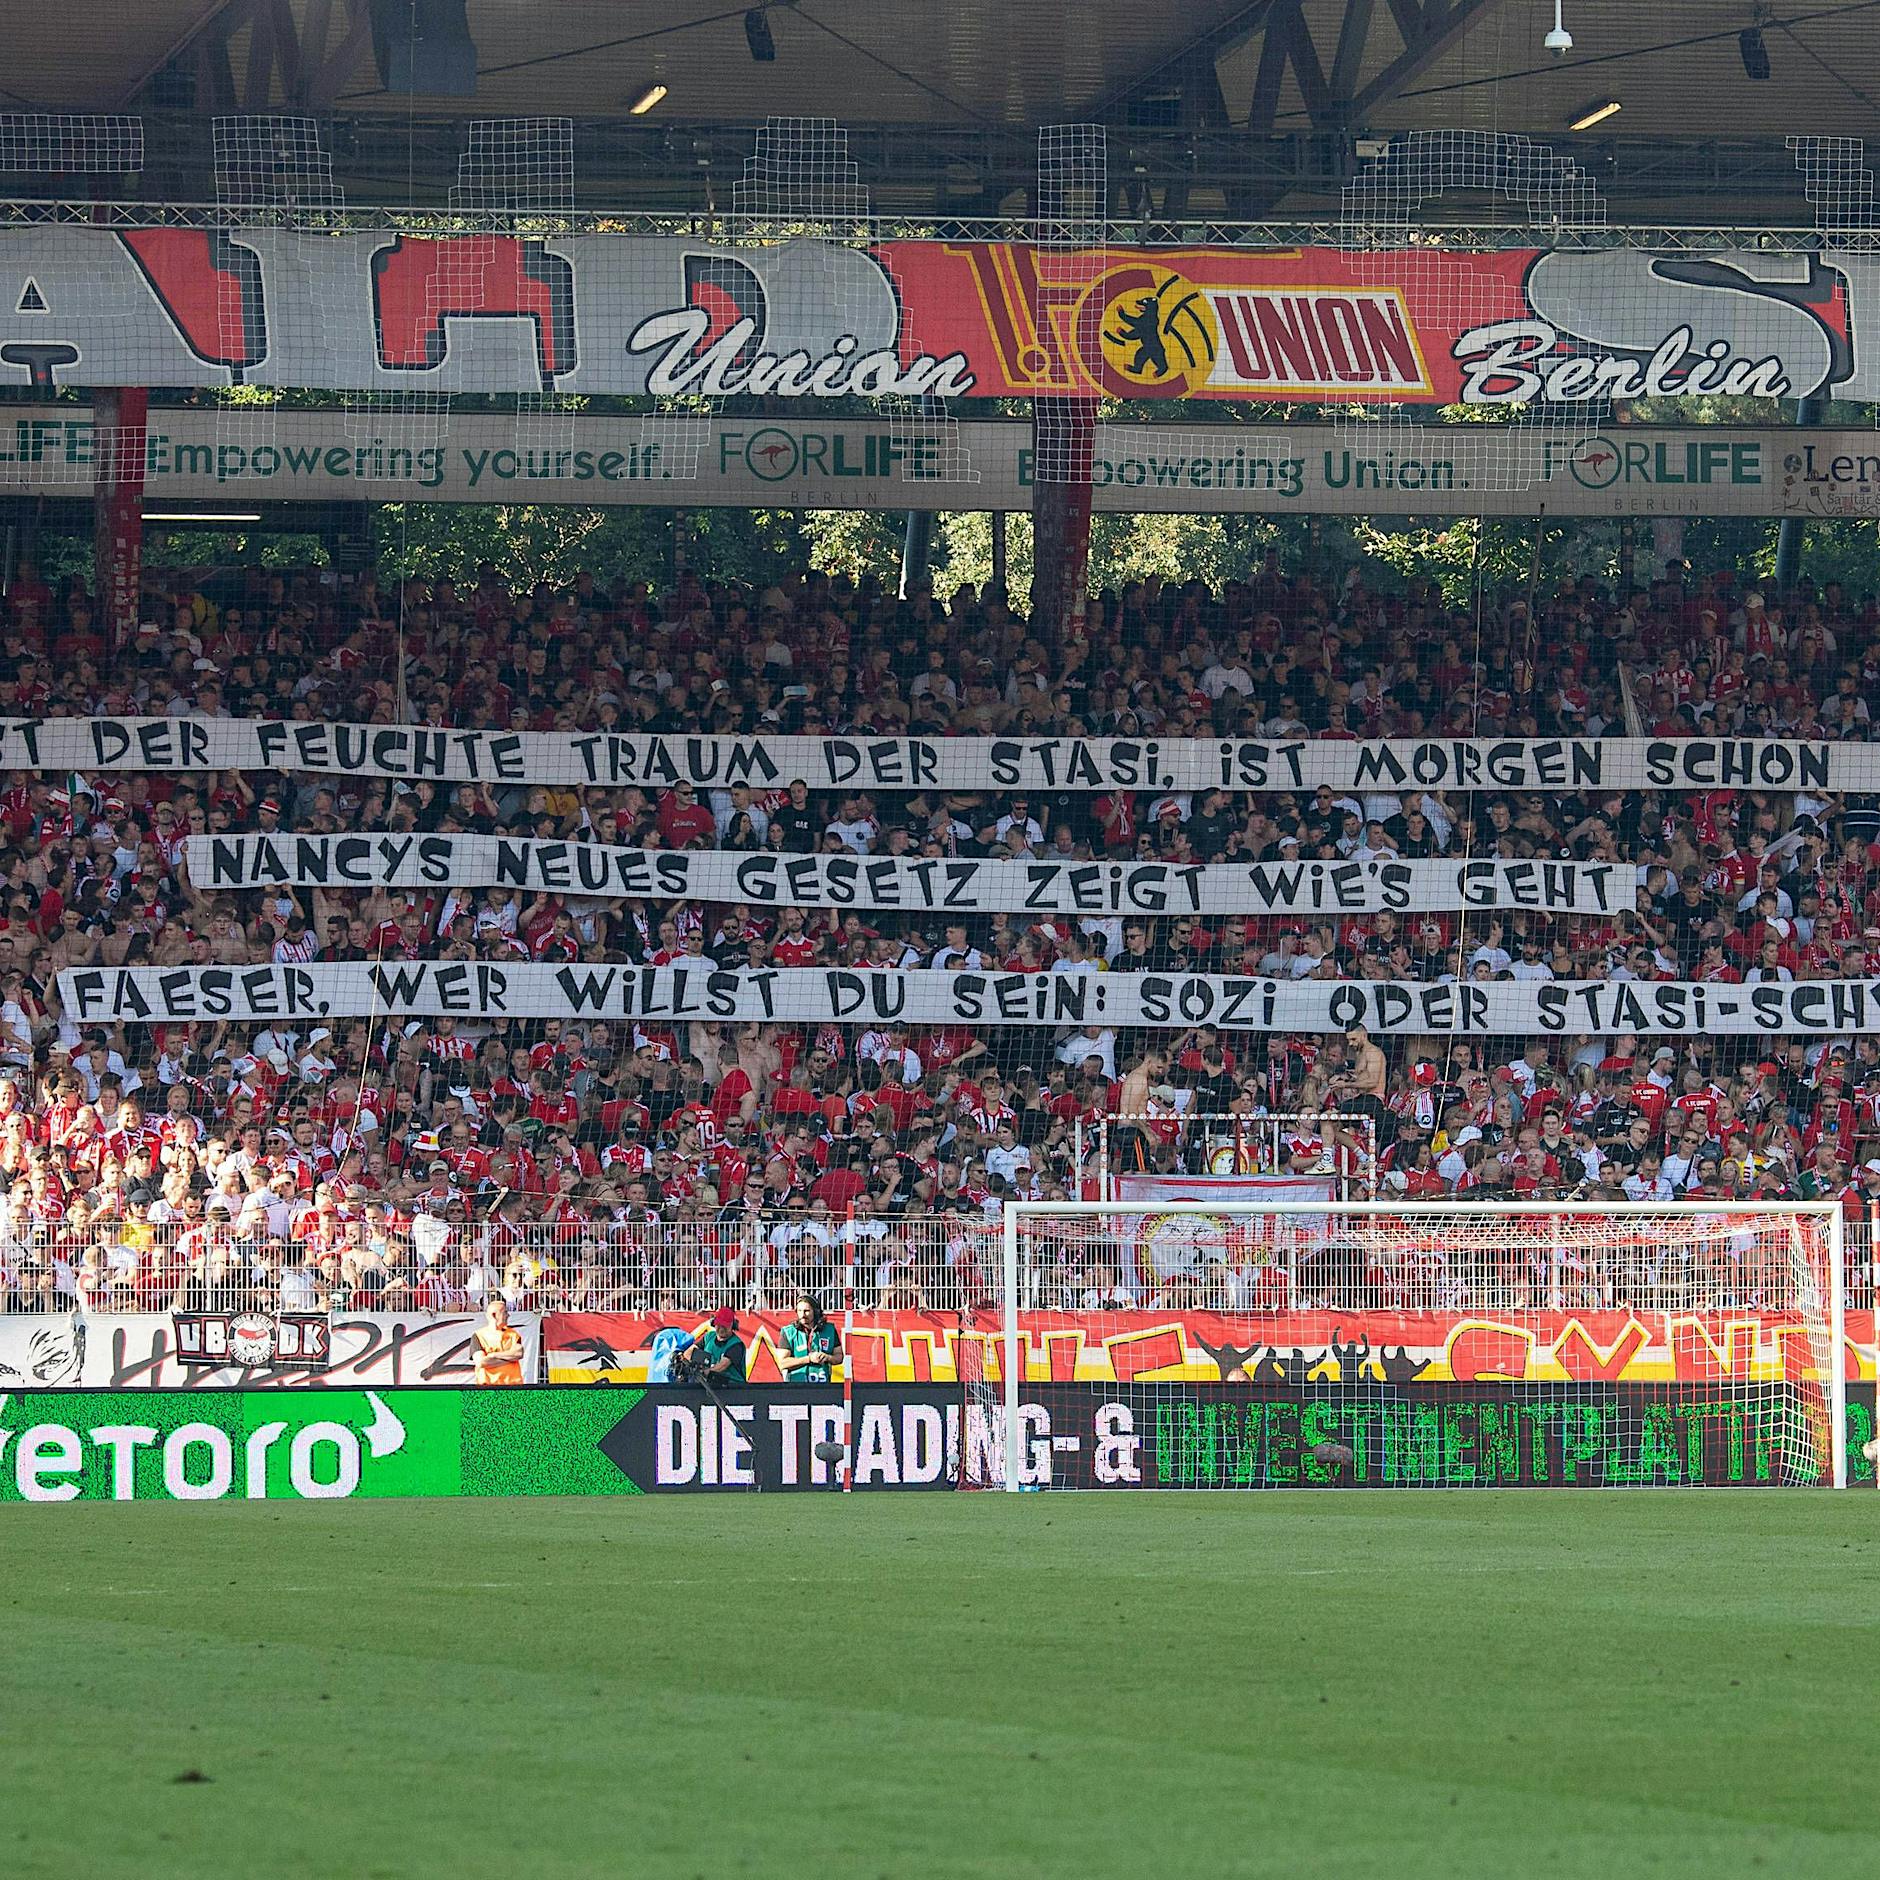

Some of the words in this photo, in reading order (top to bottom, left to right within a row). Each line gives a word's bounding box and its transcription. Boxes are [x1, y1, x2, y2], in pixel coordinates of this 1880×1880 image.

[626, 306, 975, 397] Union
[1450, 318, 1791, 401] Berlin
[1213, 296, 1424, 382] UNION
[0, 420, 95, 463] IFE
[148, 435, 446, 486] Empowering
[463, 440, 671, 487] yourself.
[1324, 450, 1470, 490] Union.
[790, 490, 878, 504] BERLIN
[1614, 499, 1700, 511] BERLIN
[0, 719, 43, 766] T
[91, 720, 209, 766] DER
[256, 721, 524, 778] FEUCHTE
[570, 736, 779, 784] TRAUM
[823, 740, 938, 785] DER
[1354, 741, 1601, 787] MORGEN
[1647, 741, 1828, 787] SCHON
[212, 834, 452, 884] NANCYS
[497, 840, 689, 893] NEUES
[737, 856, 979, 907] GESETZ
[1458, 862, 1614, 912] GEHT
[72, 967, 330, 1018] FAESER,
[368, 963, 507, 1011] WER
[827, 971, 905, 1018] DU
[1329, 983, 1488, 1030] ODER
[1537, 983, 1880, 1031] STASi-SCH
[179, 1321, 227, 1354] UB
[279, 1322, 326, 1355] DK
[656, 1404, 754, 1486] DIE
[768, 1404, 1080, 1486] TRADING-
[1094, 1402, 1142, 1483] &
